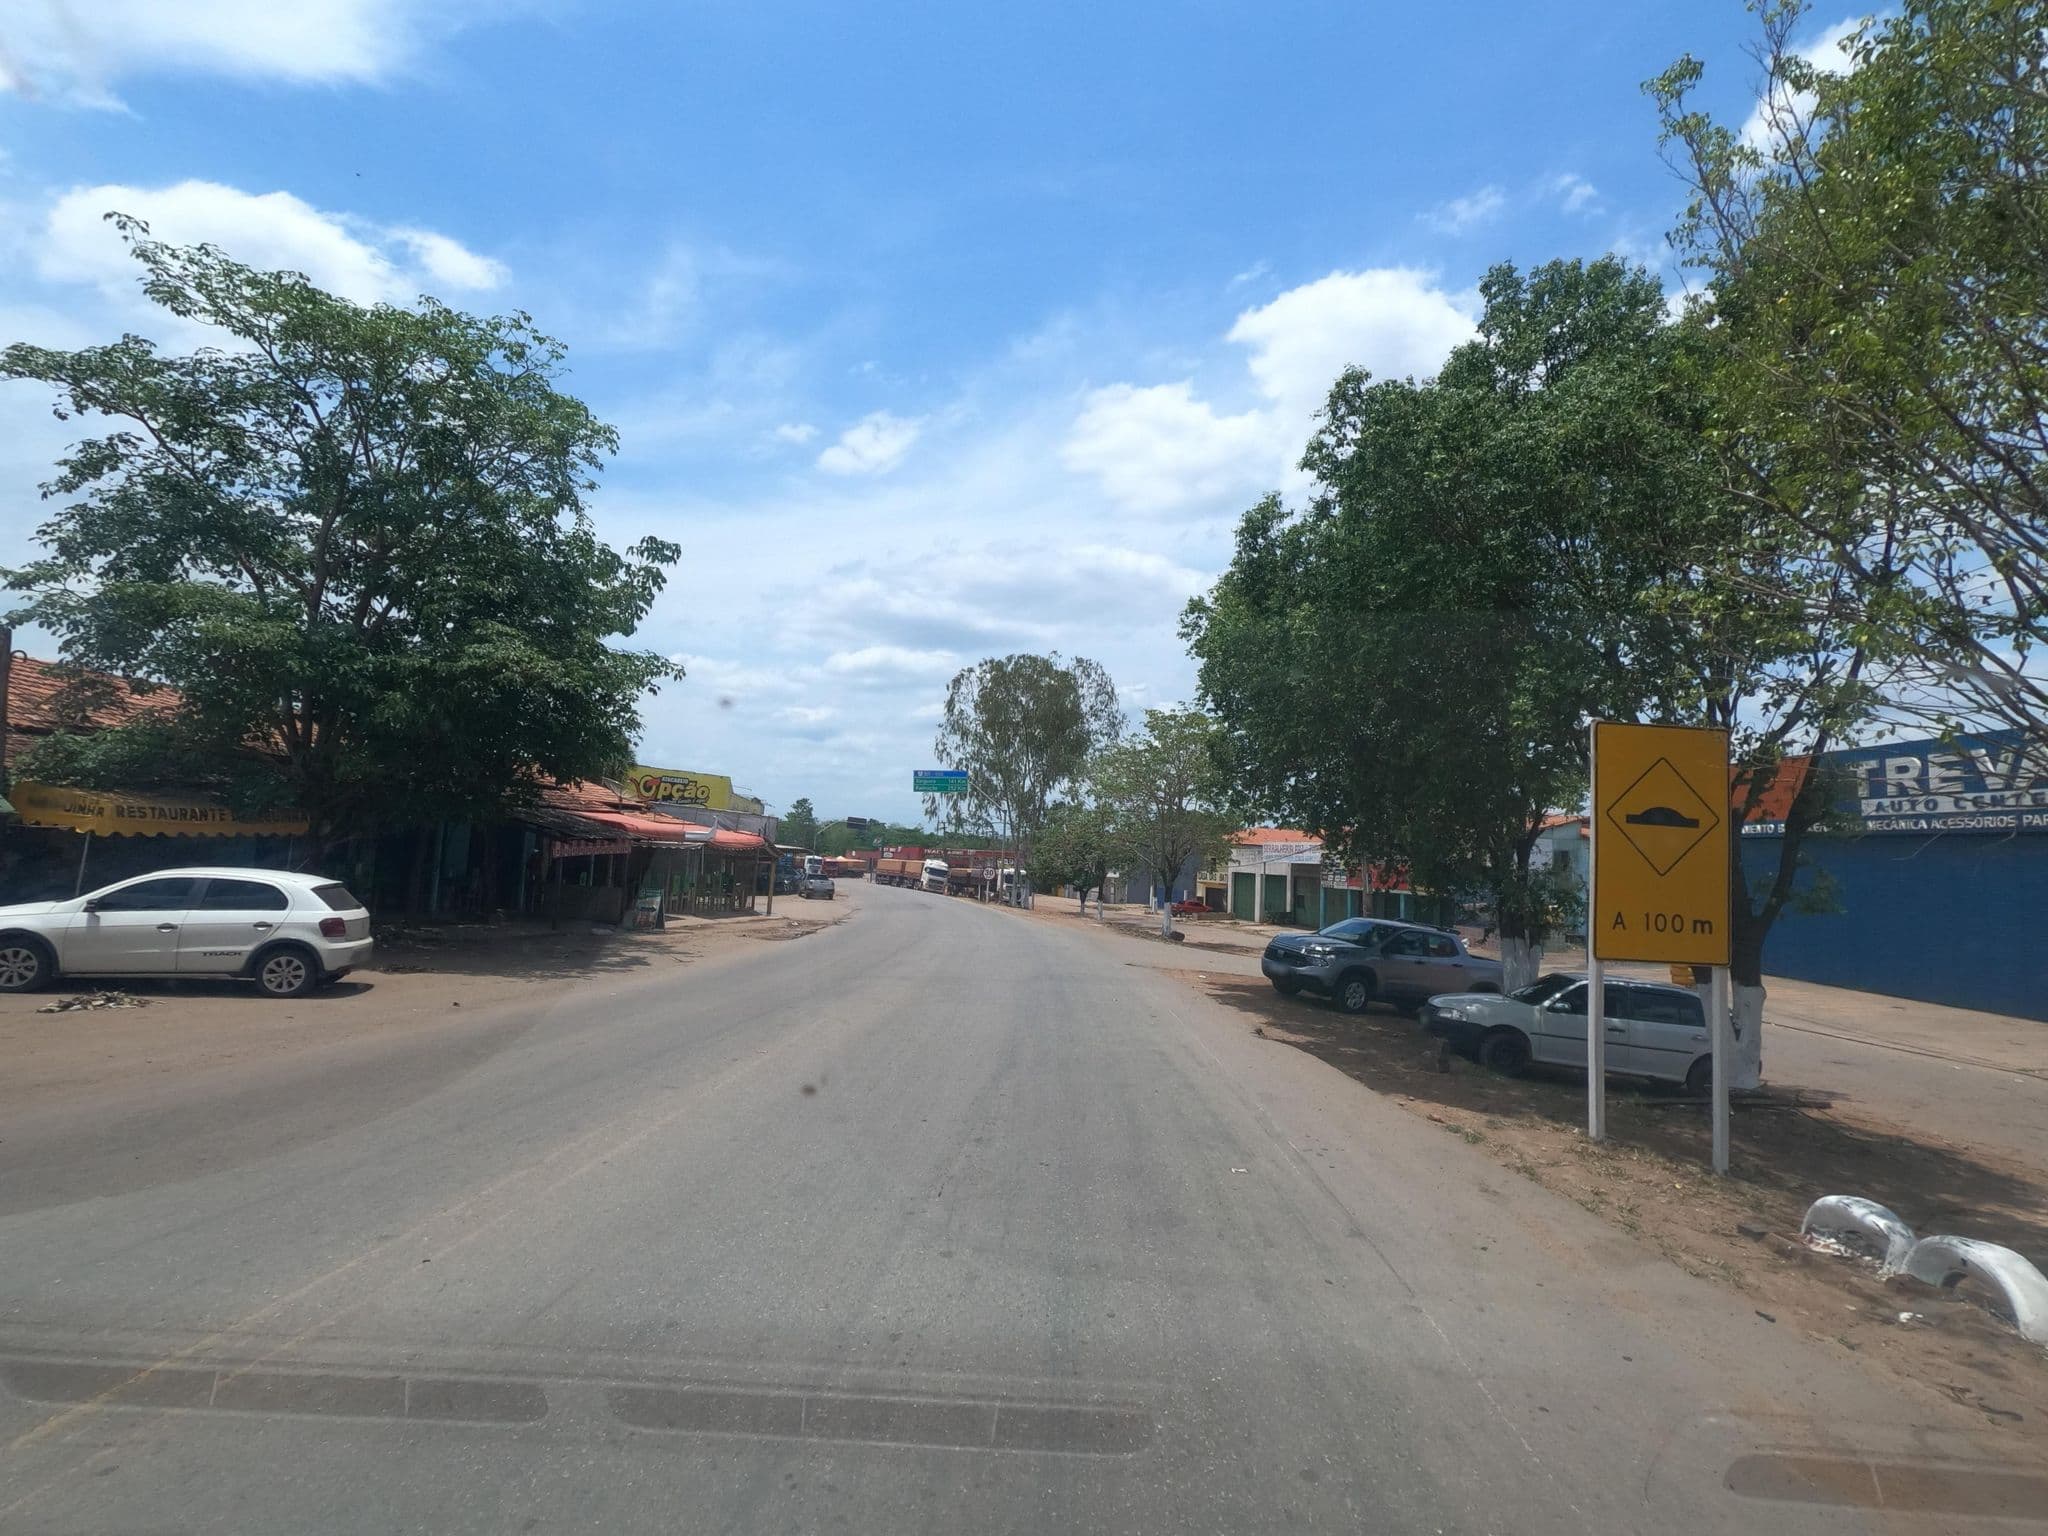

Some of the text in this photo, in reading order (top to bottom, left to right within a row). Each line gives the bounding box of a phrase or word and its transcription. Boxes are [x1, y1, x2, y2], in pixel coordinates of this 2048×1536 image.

[116, 804, 227, 822] RESTAURANTE
[1875, 798, 1938, 813] AUTO
[1866, 817, 1927, 831] MECÂNICA
[1931, 814, 2016, 830] ACESSÓRIOS
[1612, 911, 1713, 935] A 100 m
